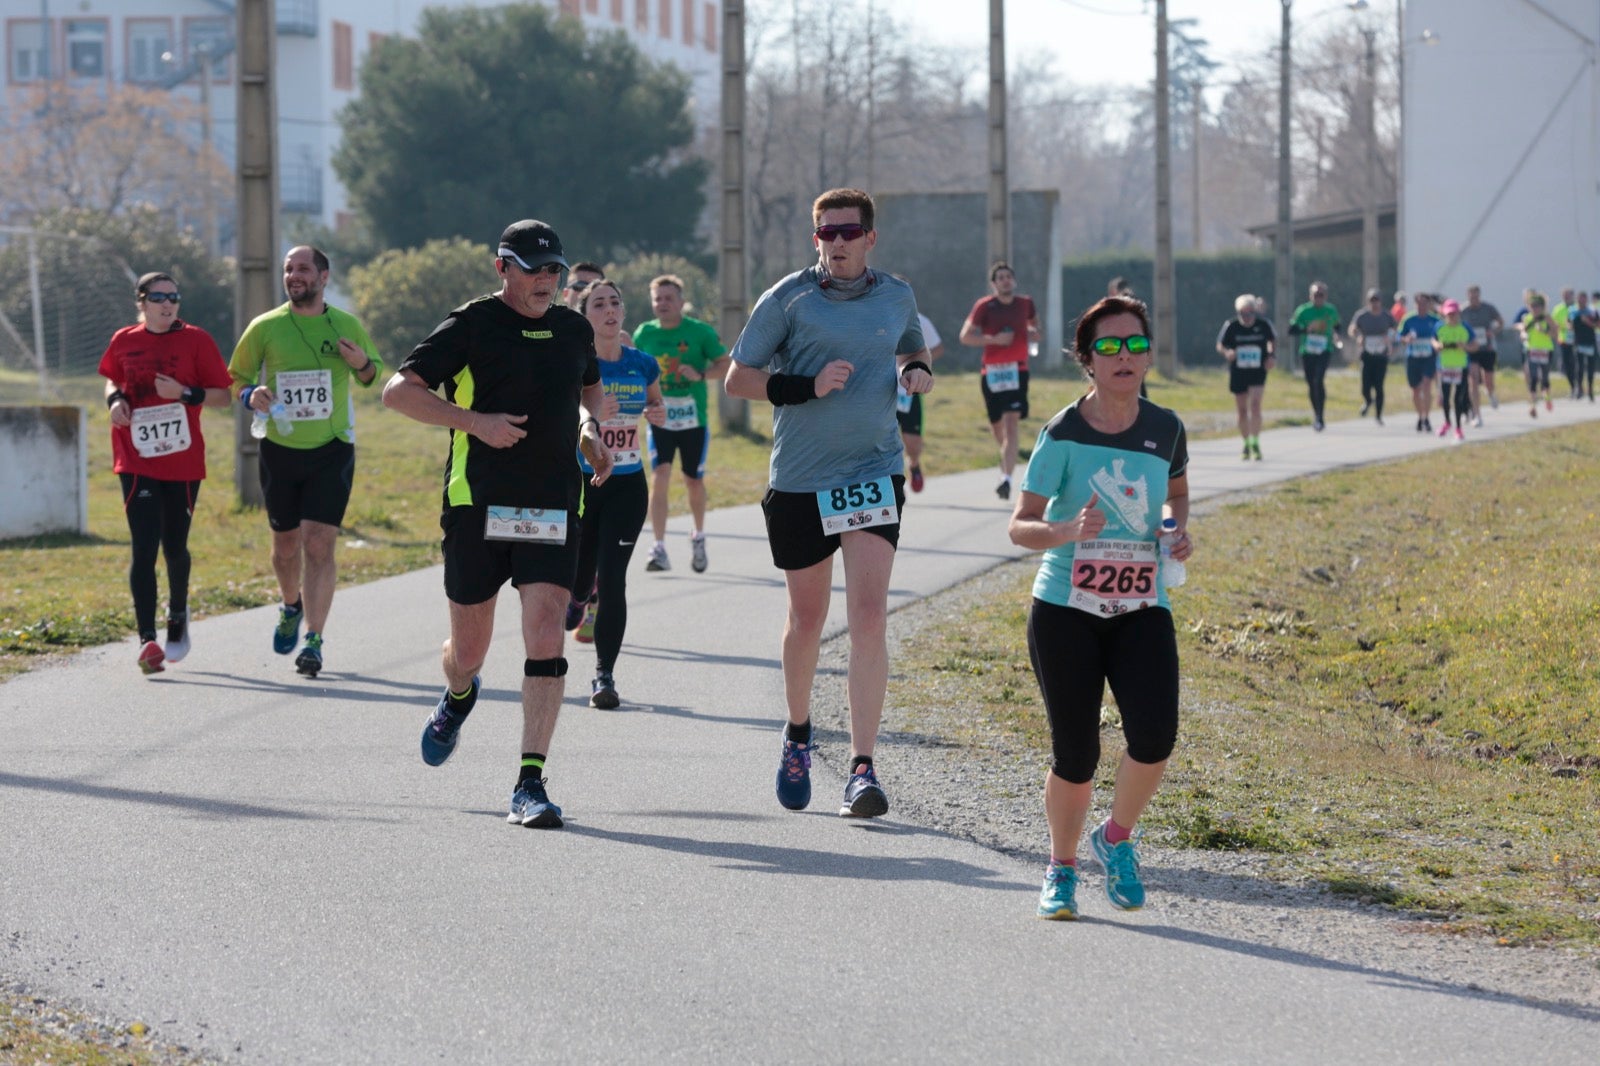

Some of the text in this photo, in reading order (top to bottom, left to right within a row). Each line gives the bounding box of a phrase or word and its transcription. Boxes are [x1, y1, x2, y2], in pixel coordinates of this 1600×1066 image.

[283, 387, 327, 405] 3178
[138, 419, 182, 442] 3177
[830, 481, 883, 511] 853
[1077, 564, 1153, 593] 2265
